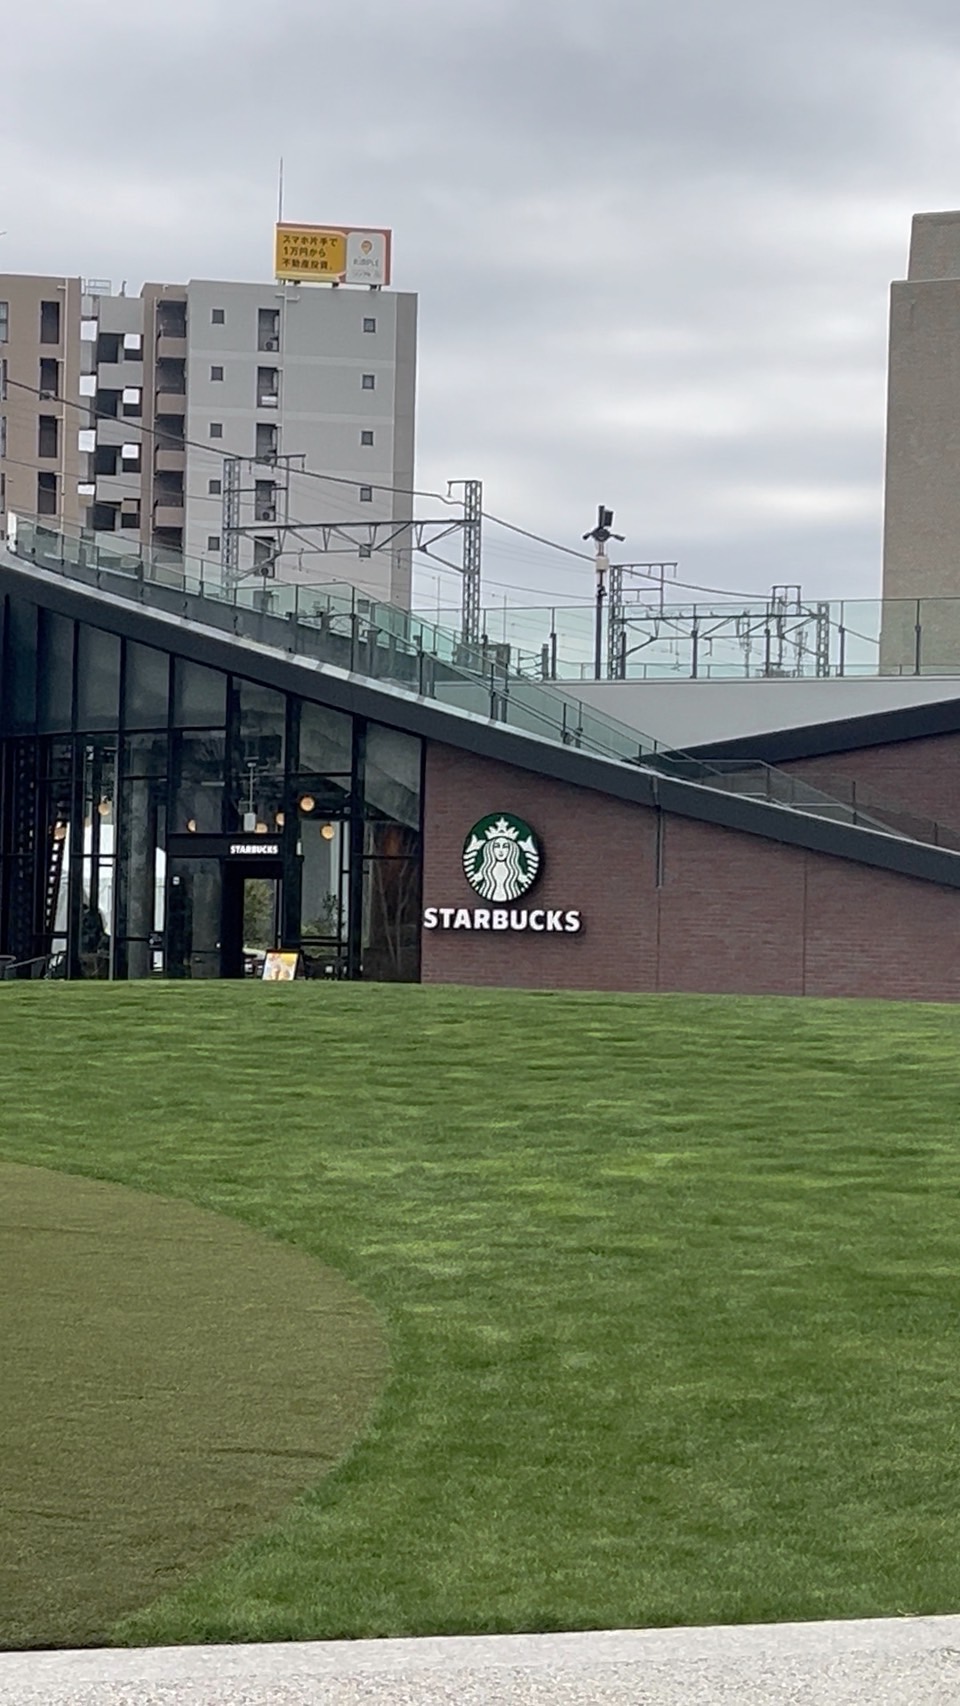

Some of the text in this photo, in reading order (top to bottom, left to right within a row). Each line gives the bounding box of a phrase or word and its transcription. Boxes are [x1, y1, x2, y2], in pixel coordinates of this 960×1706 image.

[283, 234, 339, 247] スマホ片手で
[283, 246, 327, 258] 1万円から
[230, 844, 279, 855] STARBUCKS
[423, 907, 581, 932] STARBUCKS
